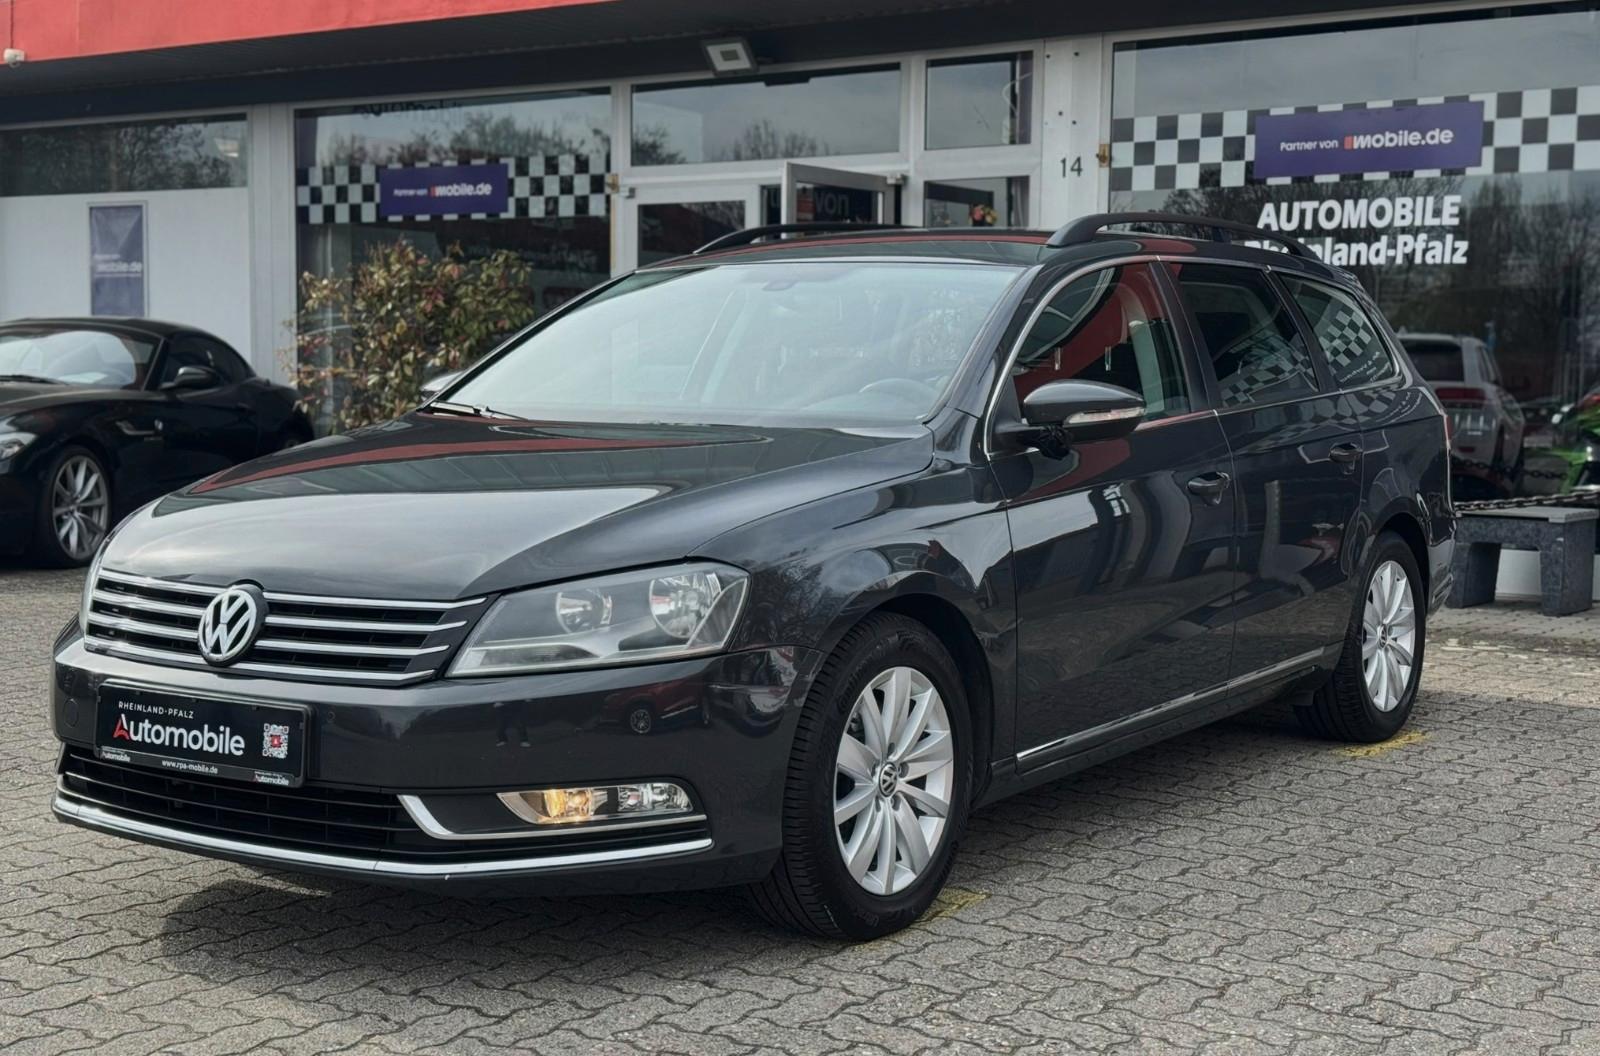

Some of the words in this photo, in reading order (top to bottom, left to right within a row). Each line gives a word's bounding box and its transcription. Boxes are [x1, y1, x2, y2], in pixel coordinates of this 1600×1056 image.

[1280, 139, 1317, 152] Partner
[1319, 138, 1339, 150] von
[1344, 127, 1454, 150] mobile.de
[1060, 156, 1083, 178] 14
[431, 183, 492, 197] mobile.de
[1256, 194, 1462, 232] AUTOMOBILE
[113, 713, 245, 756] Automobile
[162, 759, 219, 775] www.rpa-mobile.de
